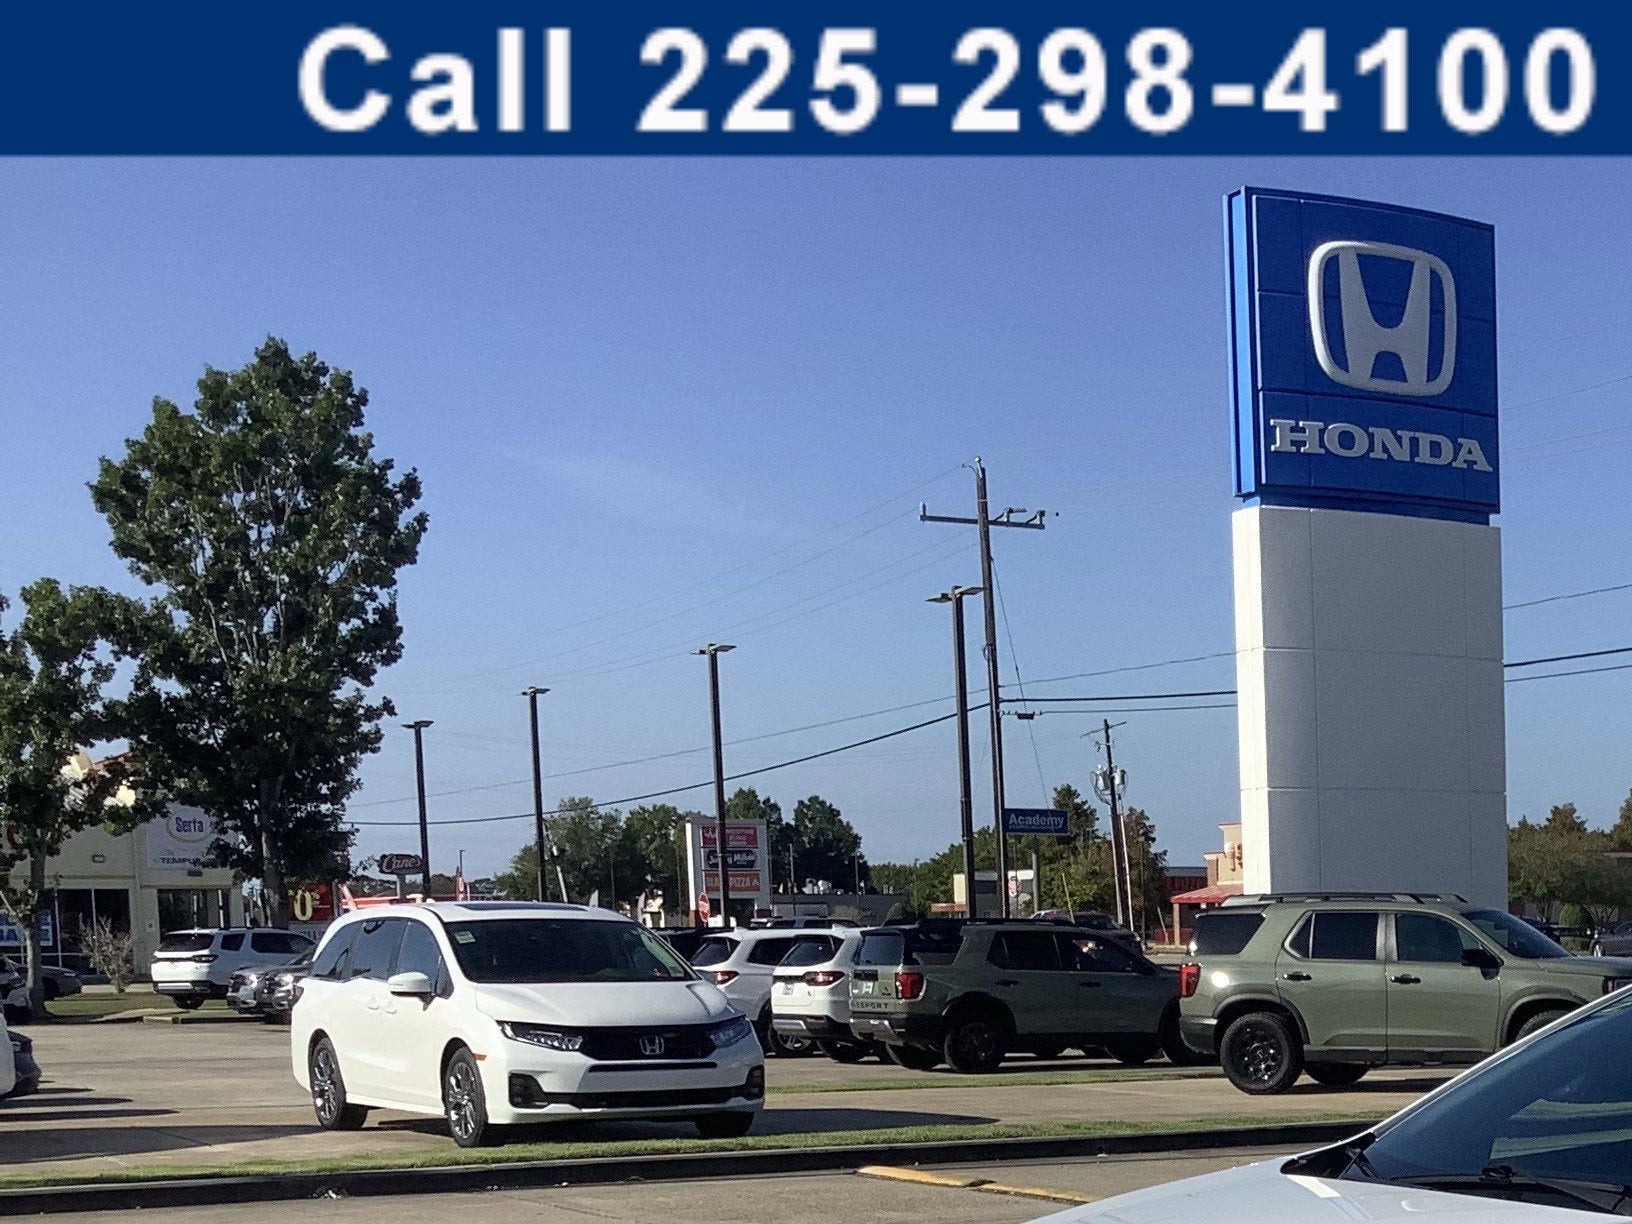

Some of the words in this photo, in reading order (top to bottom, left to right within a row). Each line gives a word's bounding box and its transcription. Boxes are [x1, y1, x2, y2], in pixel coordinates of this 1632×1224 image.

[1269, 418, 1493, 473] HONDA
[175, 817, 204, 833] Serta
[1009, 813, 1064, 829] Academy
